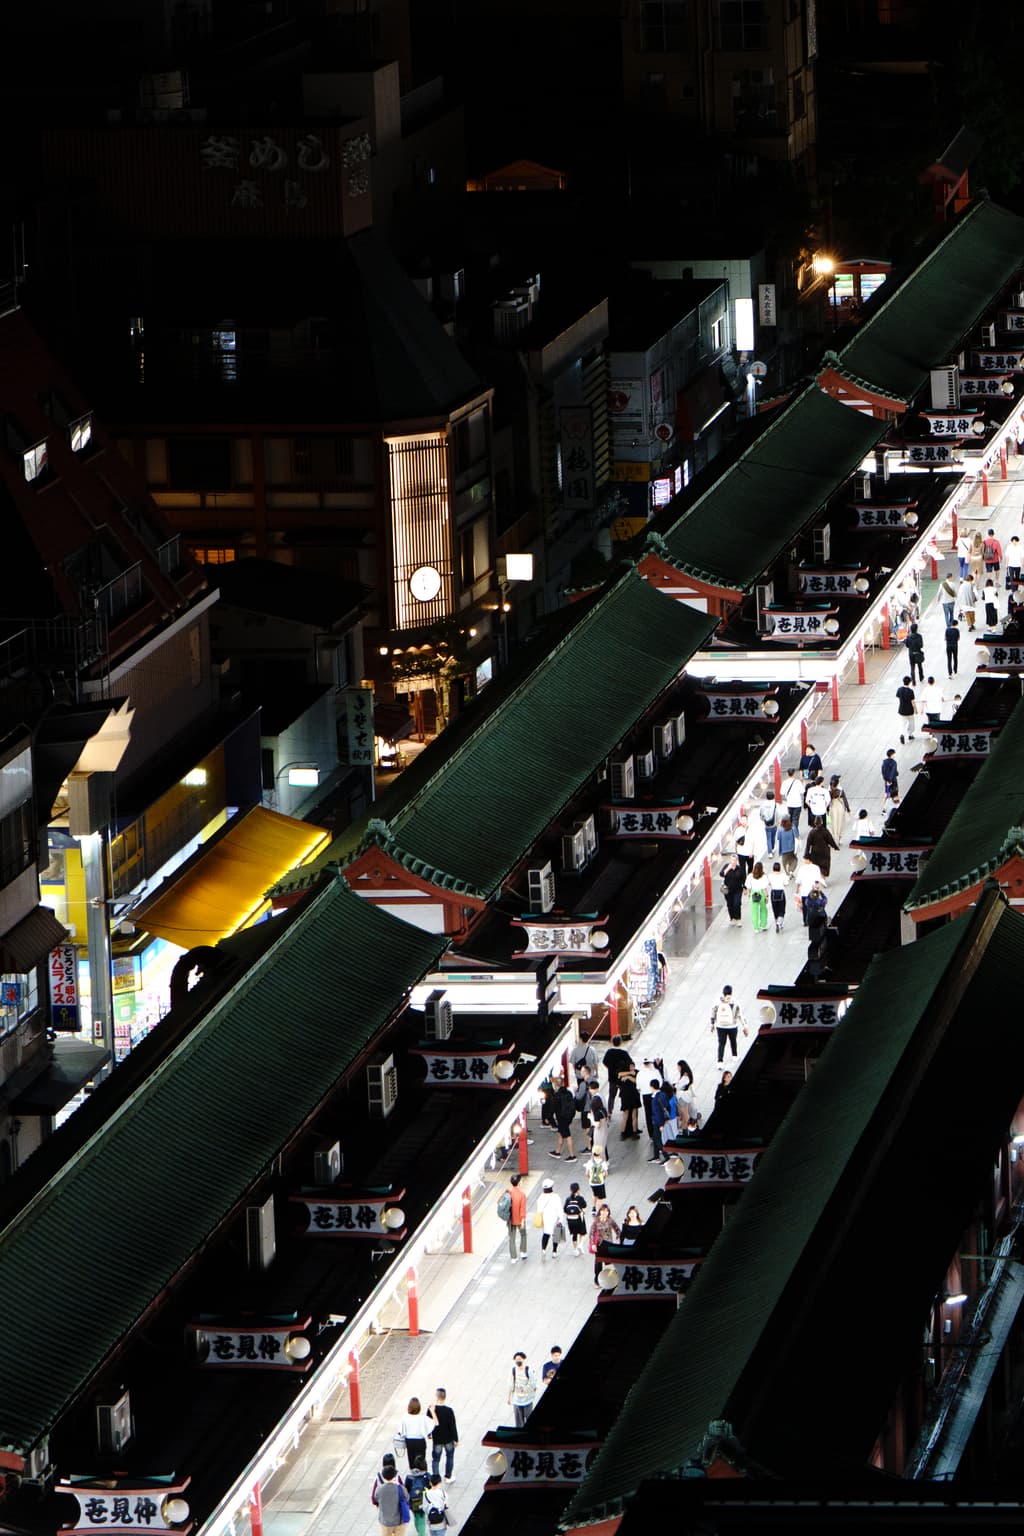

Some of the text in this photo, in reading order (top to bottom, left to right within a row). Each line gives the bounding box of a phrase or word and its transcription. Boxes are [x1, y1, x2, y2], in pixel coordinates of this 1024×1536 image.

[199, 133, 330, 172] 釜めし
[52, 948, 65, 1004] オムライス
